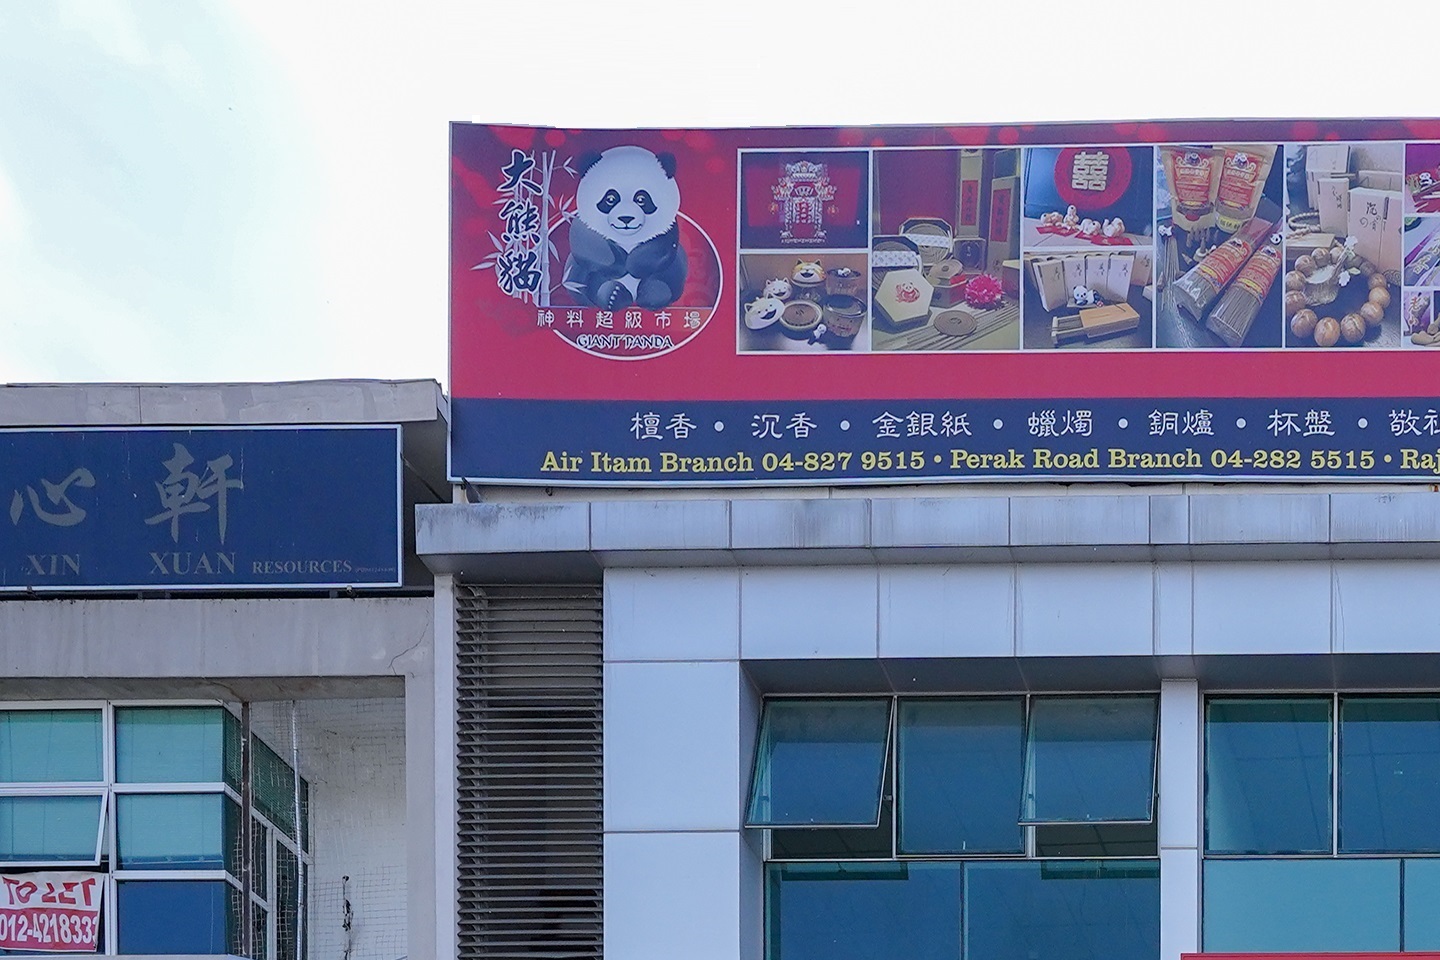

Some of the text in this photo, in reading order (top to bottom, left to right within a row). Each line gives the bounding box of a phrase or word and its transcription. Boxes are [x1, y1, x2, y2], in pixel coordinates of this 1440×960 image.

[536, 309, 702, 331] 神料超級市場
[576, 332, 673, 350] GIANT PANDA
[629, 411, 698, 441] 檀香
[750, 411, 818, 441] 沉香
[872, 411, 973, 441] 金銀紙
[1027, 410, 1094, 440] 蠟燭
[1148, 410, 1215, 439] 銅爐
[1267, 409, 1337, 438] 杯盤
[541, 450, 584, 472] Air
[590, 450, 651, 474] Itam
[659, 450, 754, 474] Branch
[762, 450, 850, 473] 04-827
[861, 449, 926, 473] 9515
[950, 449, 1026, 472] Perak
[1032, 449, 1099, 472] Road
[1108, 448, 1201, 471] Branch
[1210, 449, 1301, 470] 04-282
[1310, 449, 1374, 470] 5515
[27, 551, 352, 576] XIN XUAN RESOURCES
